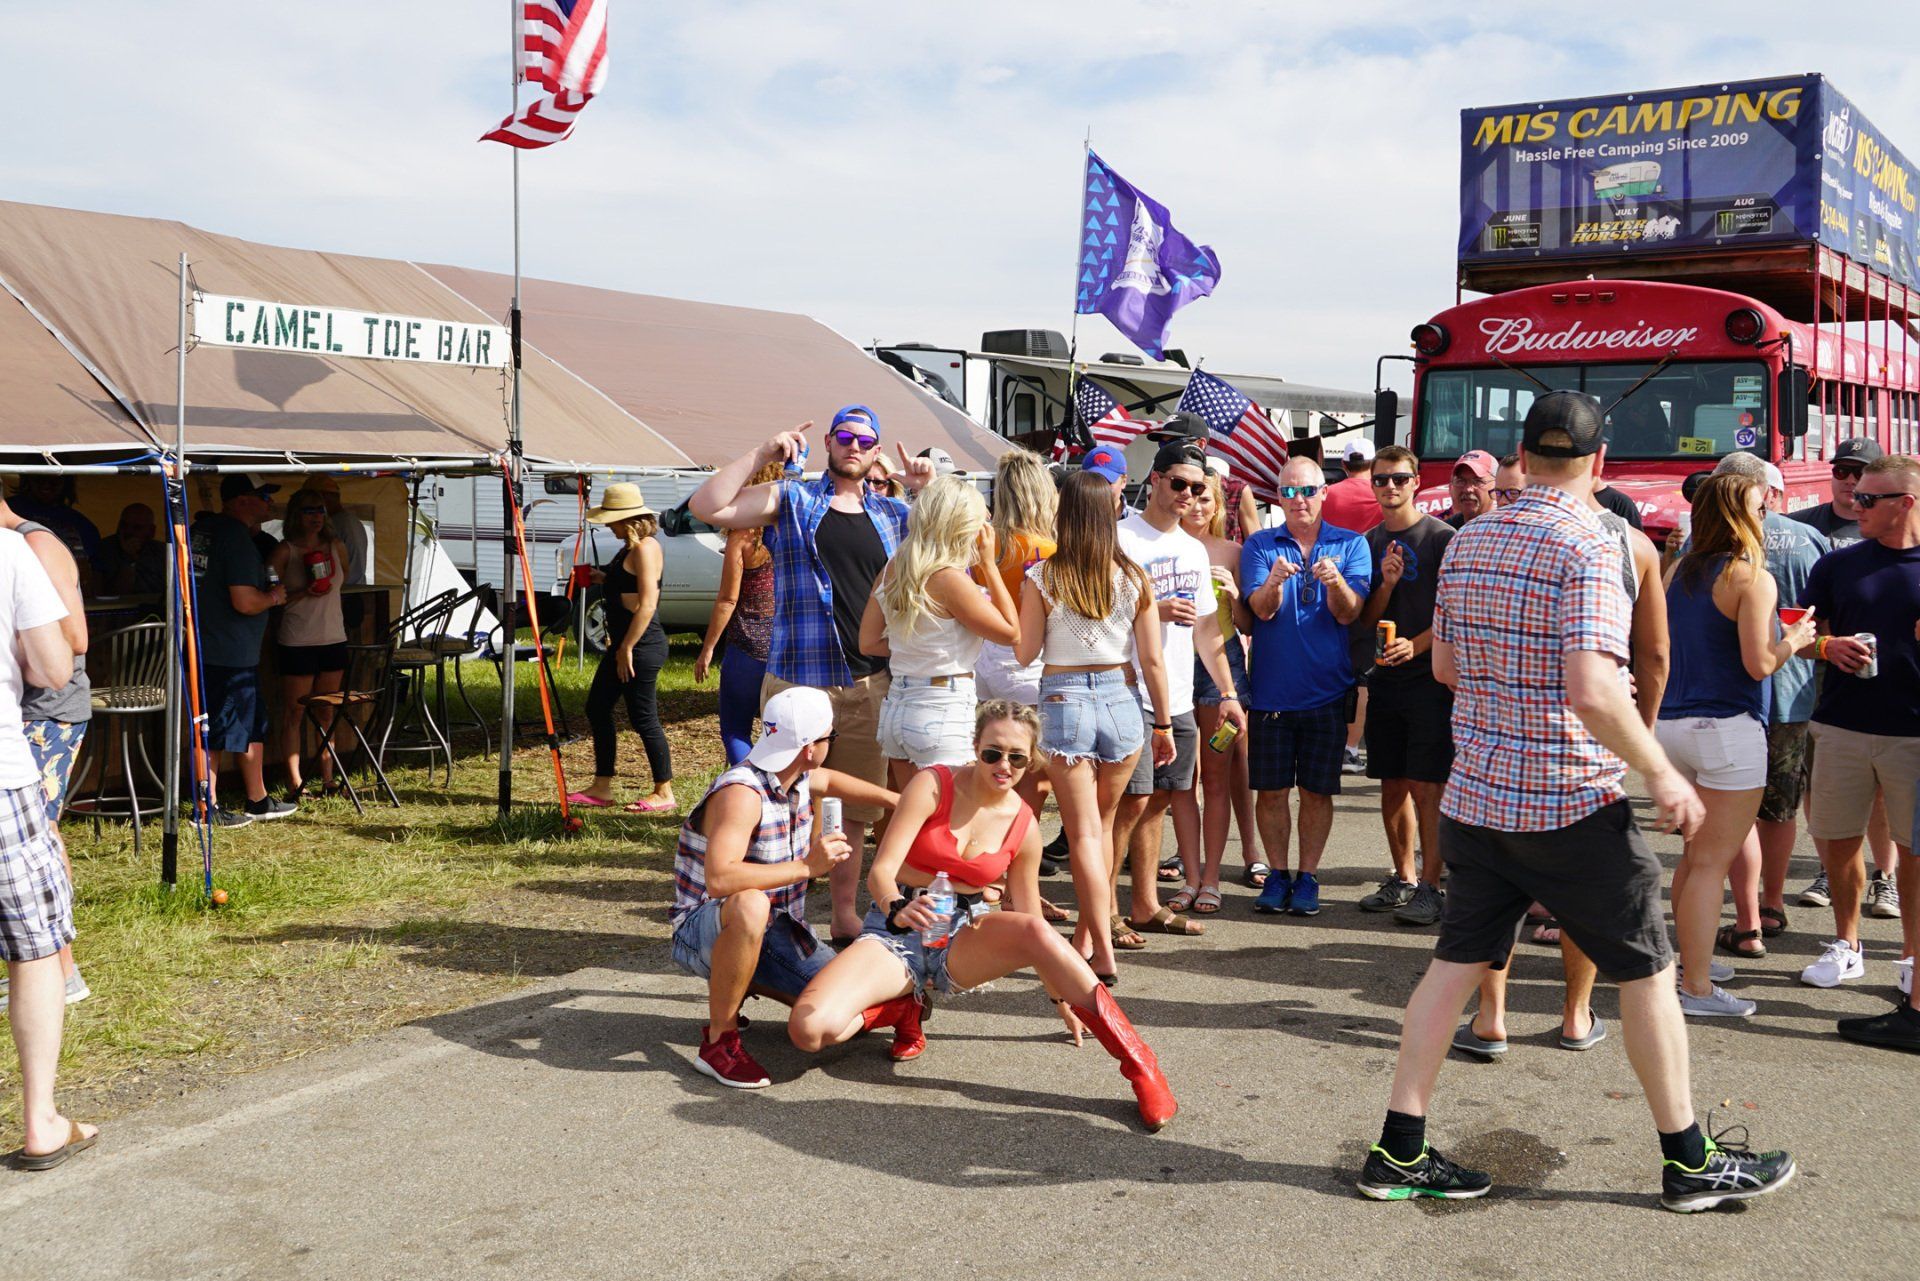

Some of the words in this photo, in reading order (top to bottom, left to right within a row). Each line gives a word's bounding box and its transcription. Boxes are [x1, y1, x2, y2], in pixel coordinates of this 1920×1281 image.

[1472, 110, 1559, 147] MIS
[1567, 87, 1803, 138] CAMPING
[1515, 149, 1561, 163] Hassle
[1564, 145, 1595, 160] Free
[1598, 140, 1664, 158] Camping
[1667, 136, 1707, 151] Since
[1711, 132, 1749, 147] 2009
[1734, 197, 1755, 207] AUG
[1615, 207, 1639, 216] JULY
[1503, 214, 1527, 223] JUNE
[1571, 230, 1643, 243] HORSES
[225, 302, 343, 352] CAMEL
[363, 317, 421, 358] TOE
[437, 325, 491, 365] BAR
[1479, 317, 1698, 354] Budweiser
[1738, 434, 1753, 443] SV
